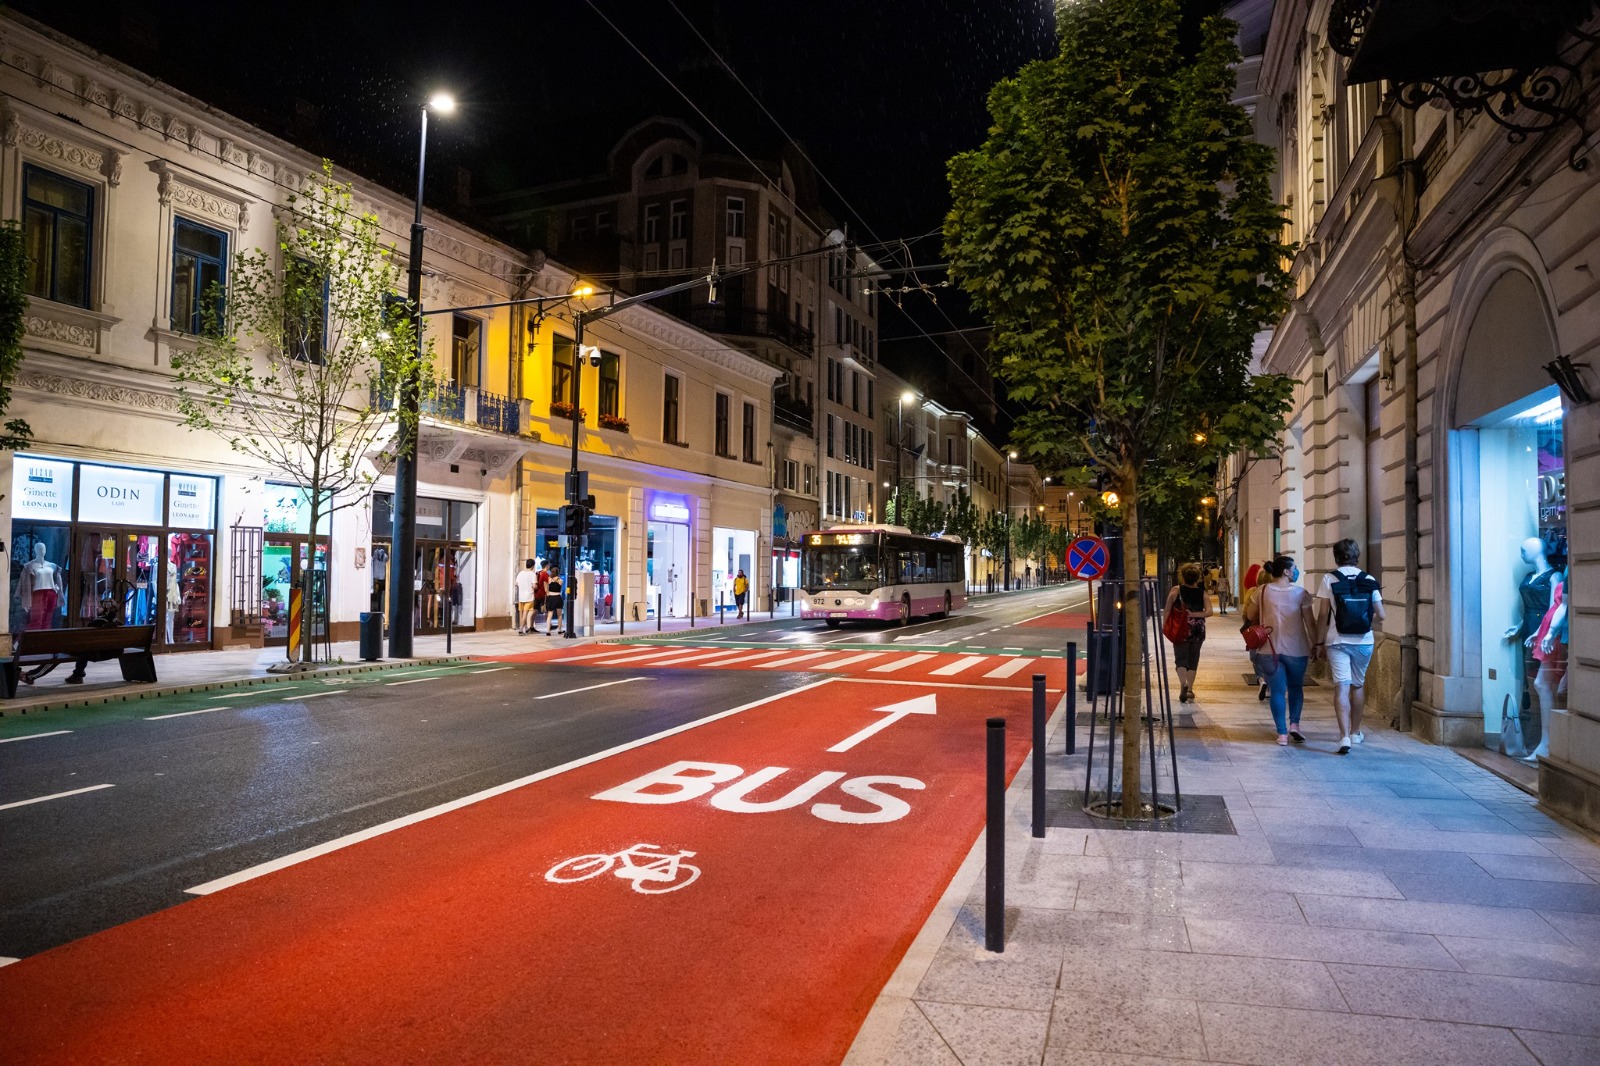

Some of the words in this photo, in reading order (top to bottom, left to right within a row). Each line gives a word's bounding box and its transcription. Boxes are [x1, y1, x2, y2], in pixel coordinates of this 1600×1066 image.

[23, 486, 57, 498] Ginette
[97, 485, 140, 500] ODIN
[22, 500, 58, 508] LEONARD
[811, 534, 822, 546] 35
[590, 759, 926, 825] BUS
